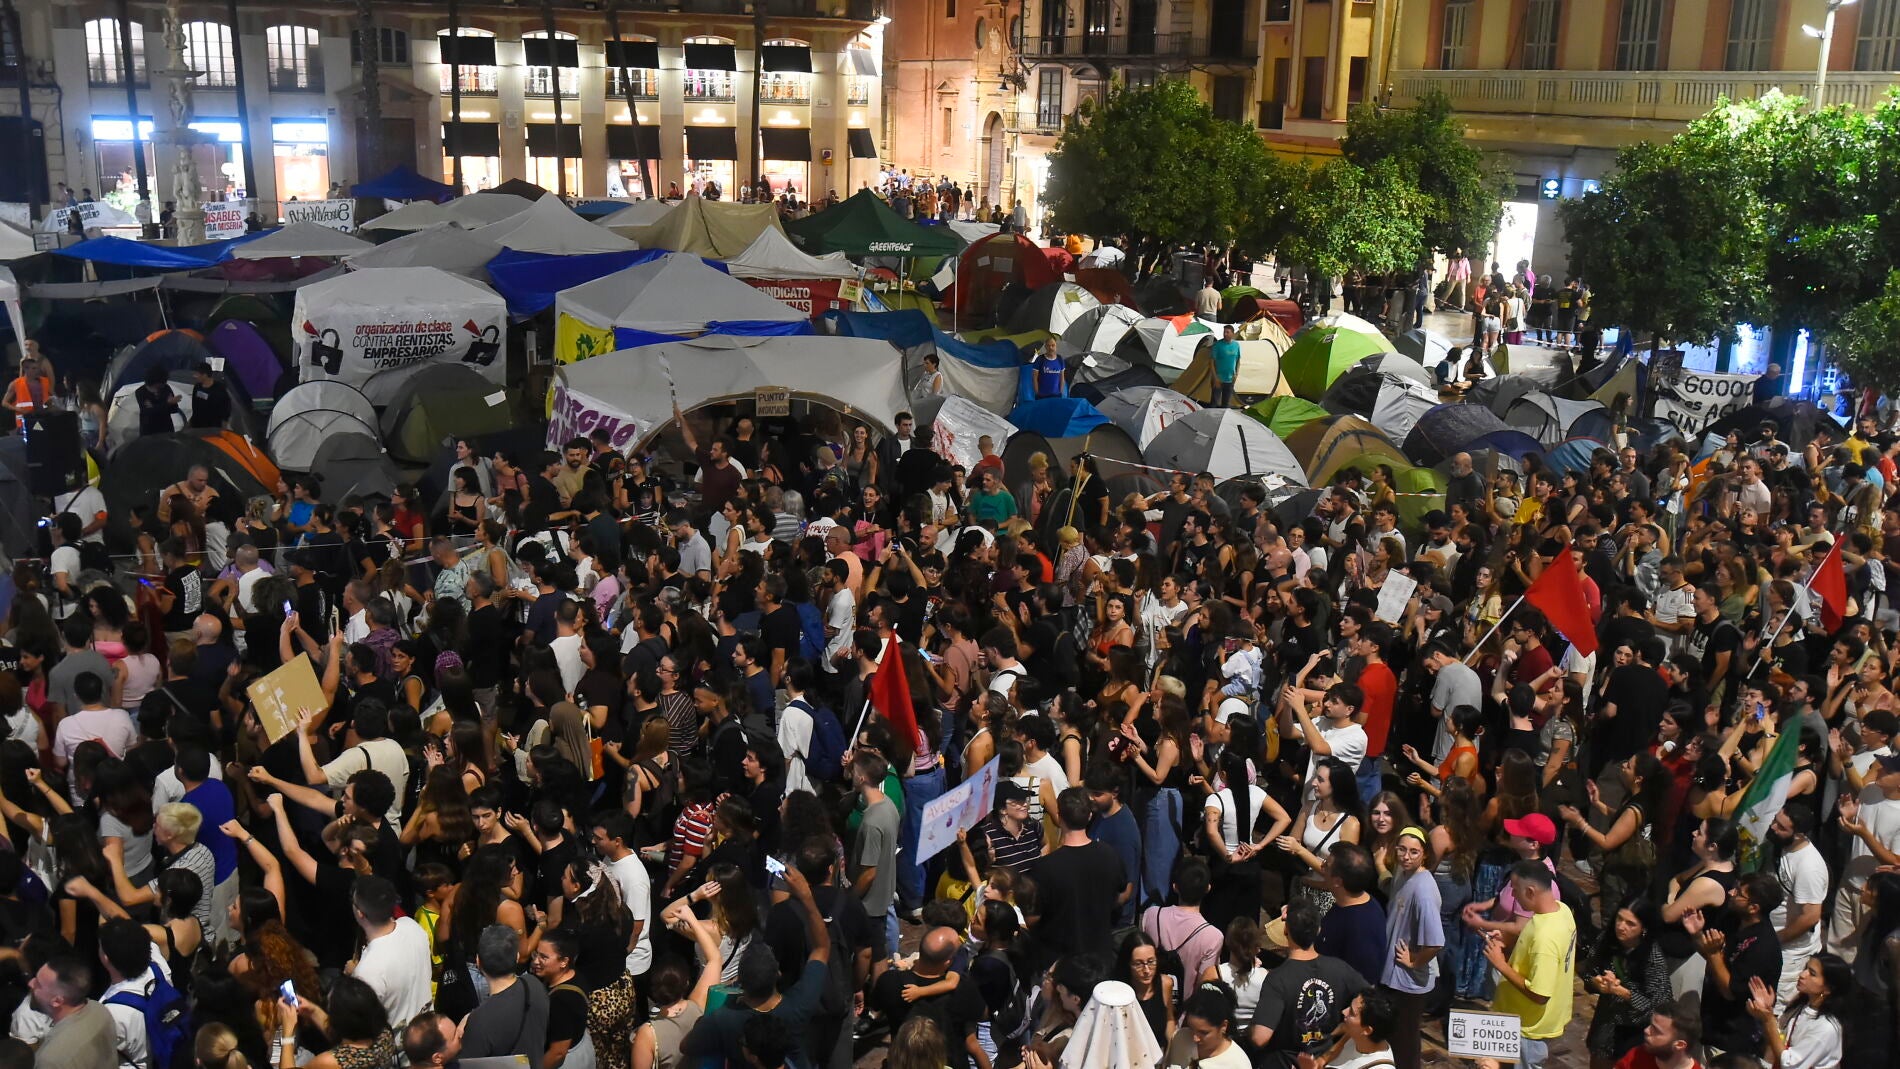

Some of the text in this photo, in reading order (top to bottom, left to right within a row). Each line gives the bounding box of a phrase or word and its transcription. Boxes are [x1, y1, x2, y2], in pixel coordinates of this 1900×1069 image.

[869, 242, 914, 252] GREENPEACE
[355, 320, 452, 336] organización de clase
[352, 333, 456, 348] CONTRA RENTISTAS,
[363, 345, 446, 359] EMPRESARIOS
[374, 359, 381, 369] Y
[758, 392, 785, 401] PUNTO
[1667, 410, 1698, 435] SIN
[1481, 1019, 1505, 1027] CALLE
[1473, 1028, 1518, 1041] FONDOS
[1472, 1040, 1519, 1053] BUITRES
